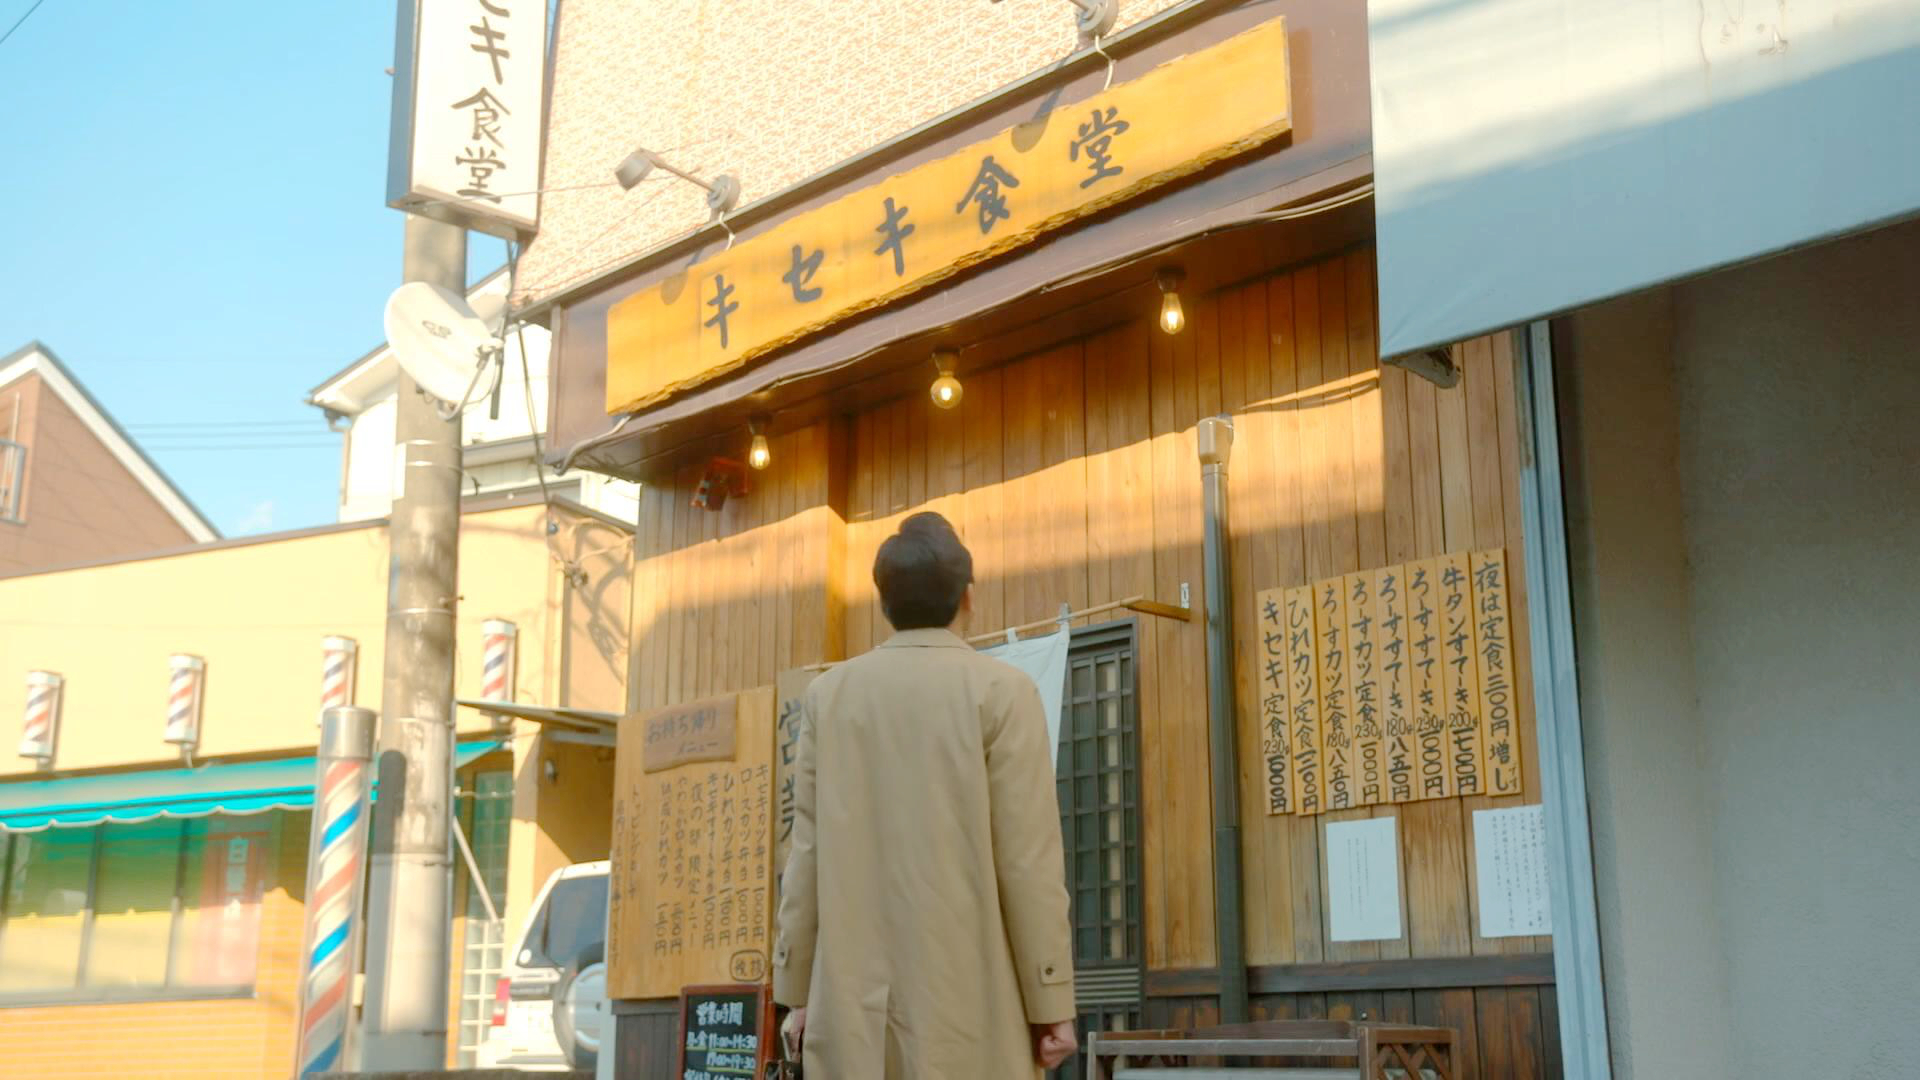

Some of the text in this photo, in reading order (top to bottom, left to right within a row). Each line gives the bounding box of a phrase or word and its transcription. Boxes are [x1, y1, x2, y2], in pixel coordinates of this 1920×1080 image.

[703, 106, 1130, 349] キセキ食堂
